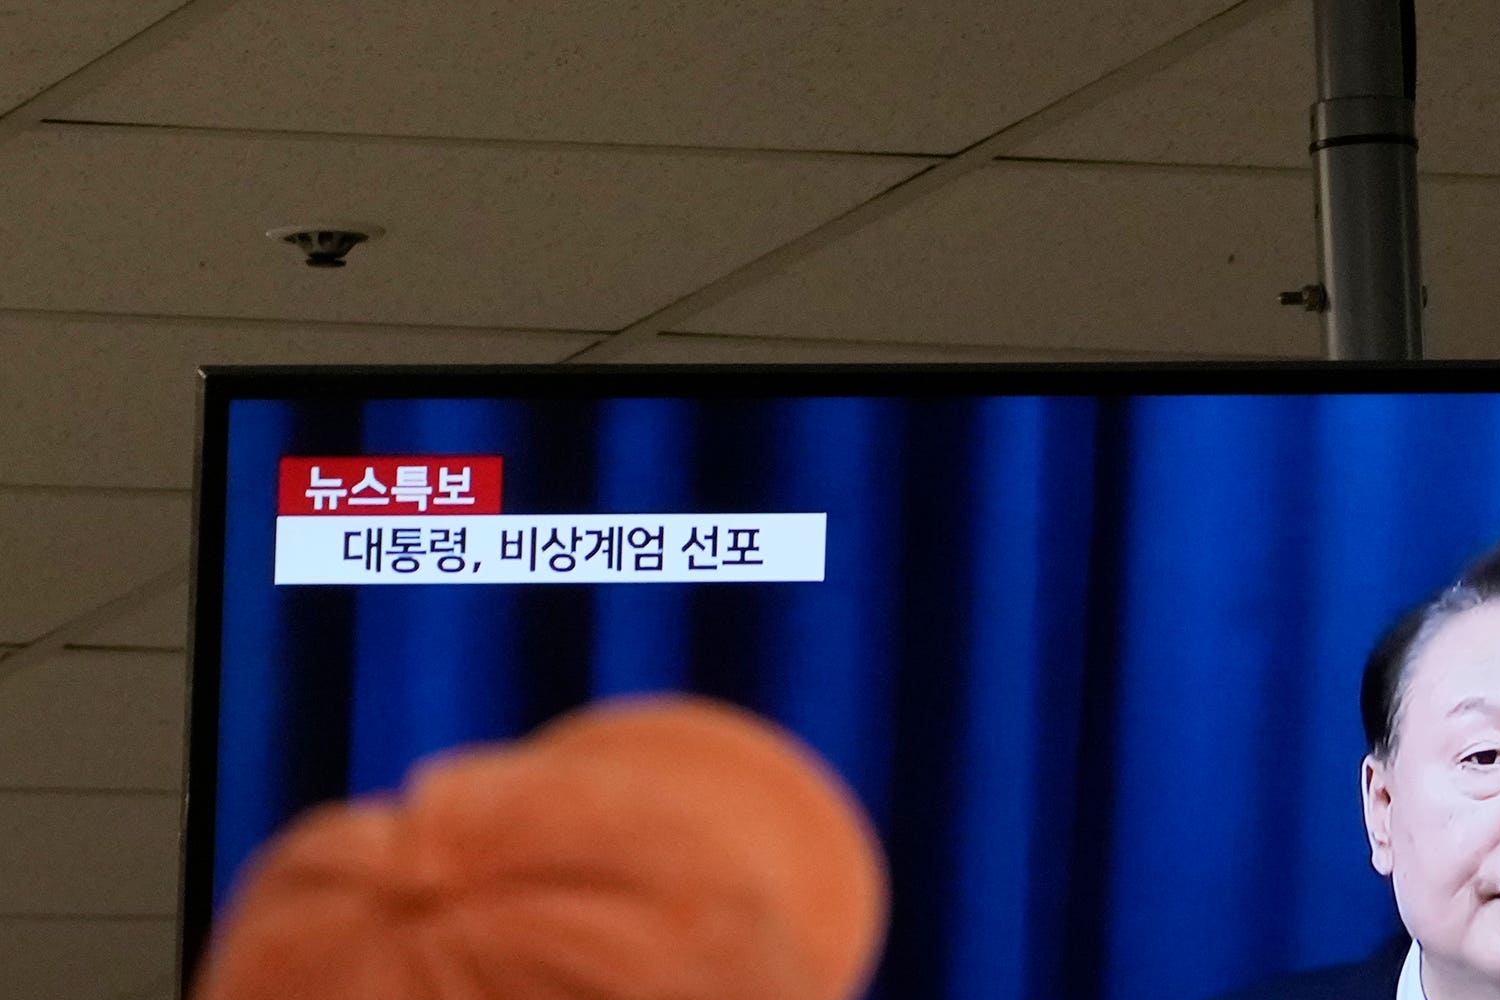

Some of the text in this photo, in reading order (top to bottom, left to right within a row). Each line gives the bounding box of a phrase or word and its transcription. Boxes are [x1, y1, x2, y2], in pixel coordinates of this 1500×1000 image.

[304, 465, 476, 512] 뉴스특보
[342, 525, 765, 575] 대통령, 비상계엄 선포
